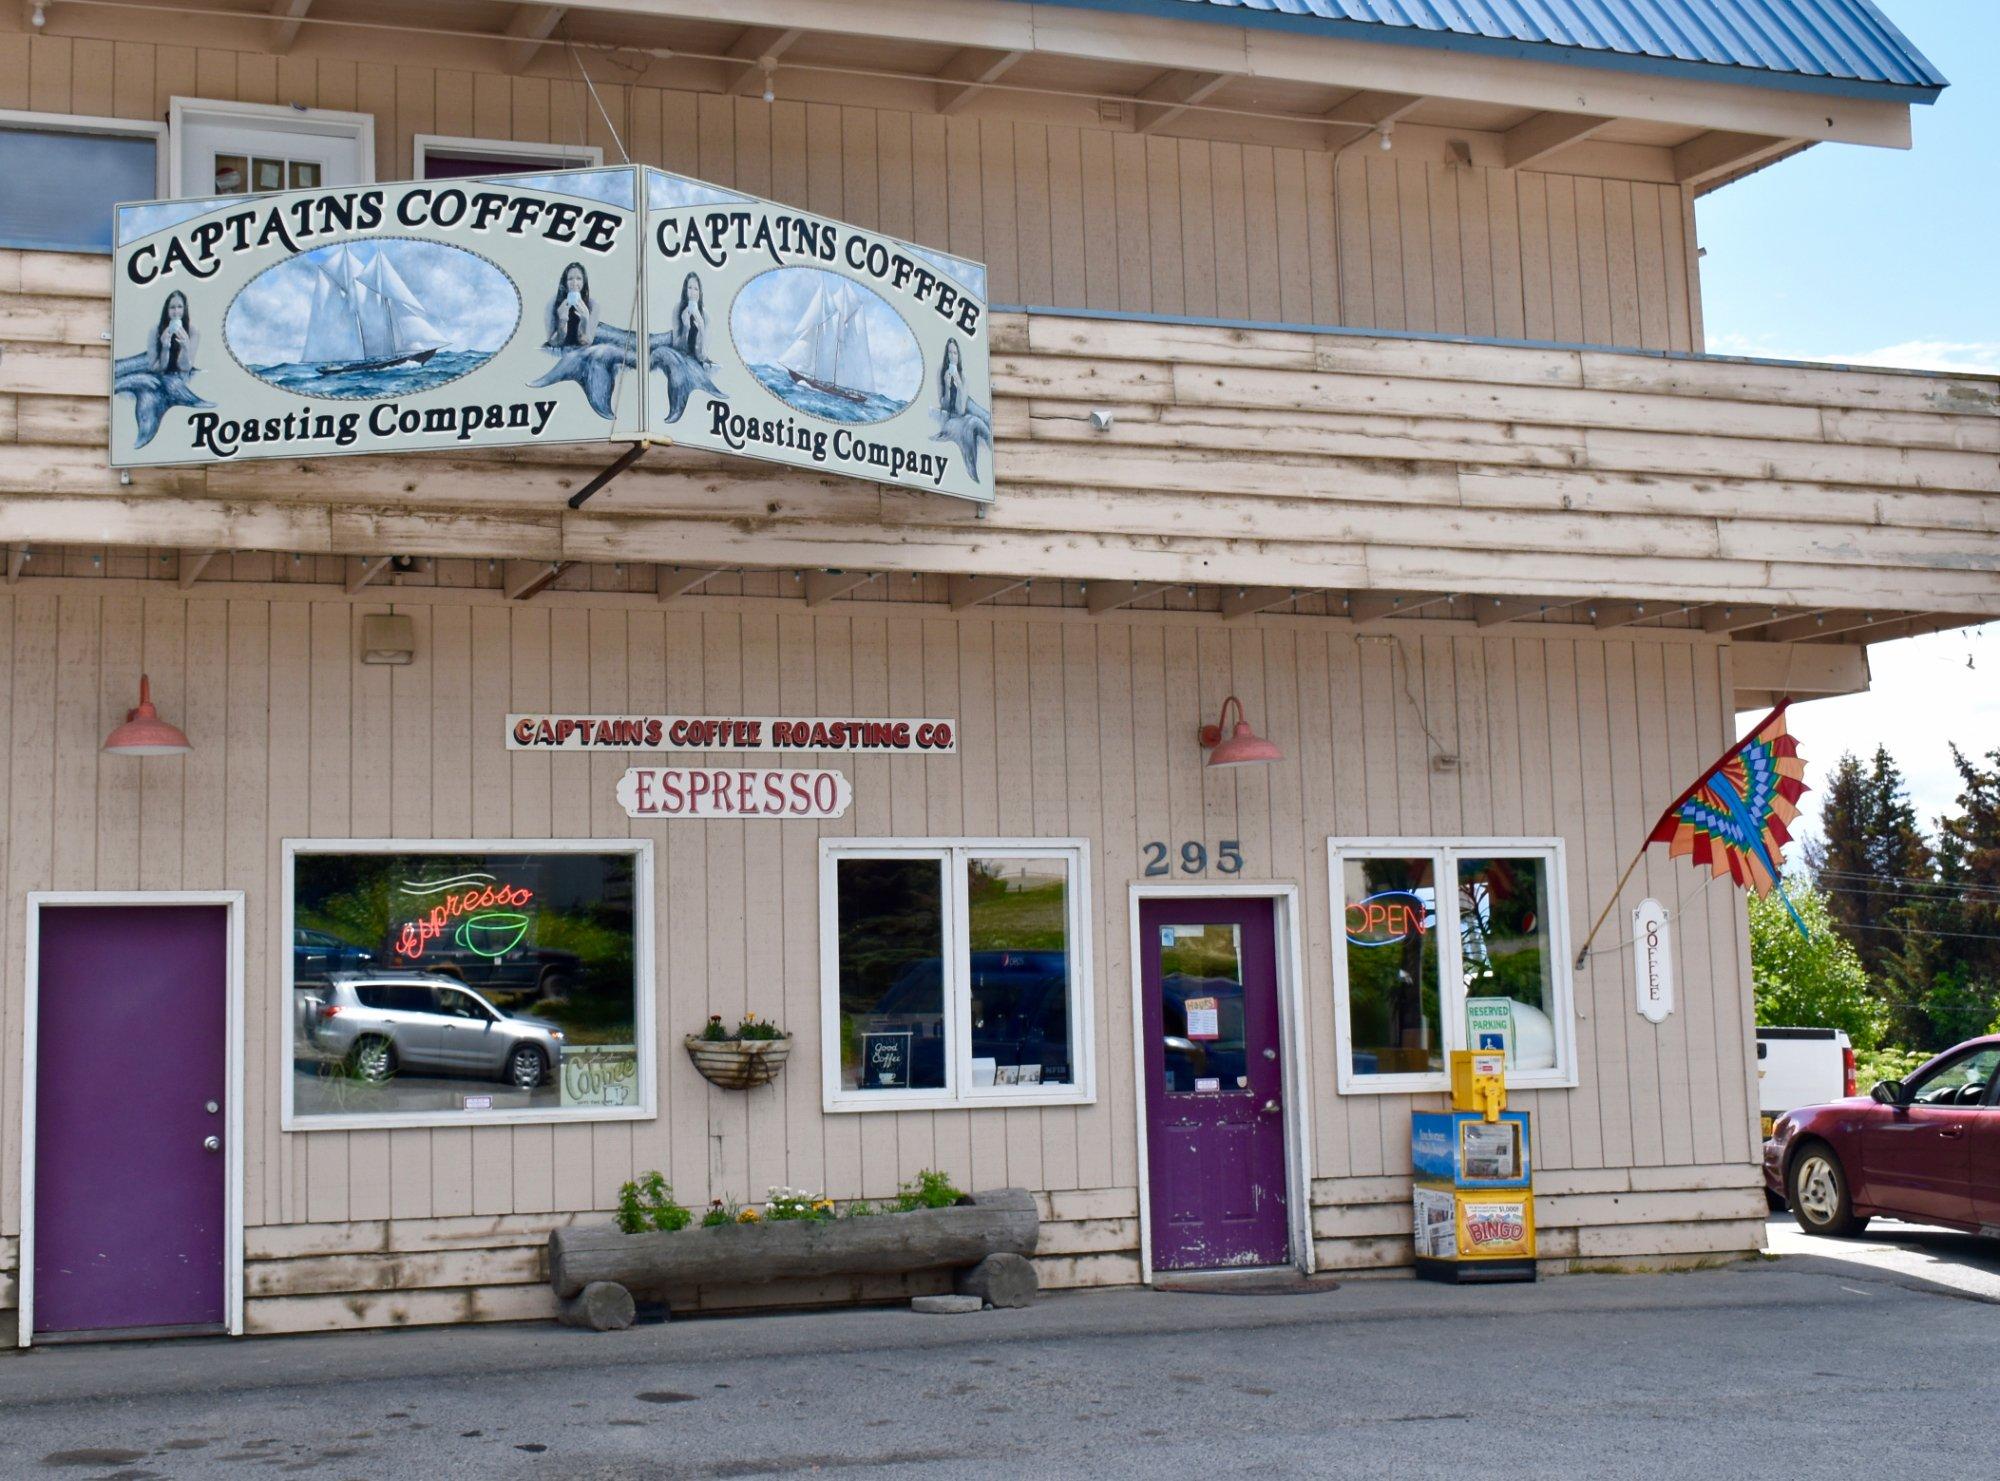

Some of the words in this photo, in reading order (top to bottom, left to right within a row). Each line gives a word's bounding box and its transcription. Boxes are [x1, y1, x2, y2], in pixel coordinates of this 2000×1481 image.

[127, 190, 385, 285] CAPTAINS
[396, 188, 623, 253] COFFEE
[656, 212, 838, 268] CAPTAINS
[844, 235, 981, 337] COFFEE
[187, 405, 360, 458] Roasting
[369, 400, 557, 440] Company
[706, 400, 828, 462] Roasting
[832, 430, 948, 485] Company
[513, 718, 663, 747] CAPTAIN'S
[668, 719, 762, 748] COFFEE
[773, 721, 910, 749] ROASTING
[916, 723, 955, 749] CO.
[635, 770, 840, 814] ESPRESSO
[1142, 840, 1244, 877] 295
[1344, 902, 1427, 935] OPEN
[1646, 920, 1660, 1001] COFFEE
[1469, 1006, 1509, 1017] RESERVED
[1472, 1020, 1508, 1031] PARKING
[874, 1043, 898, 1055] Good
[1467, 1221, 1524, 1245] BINGO
